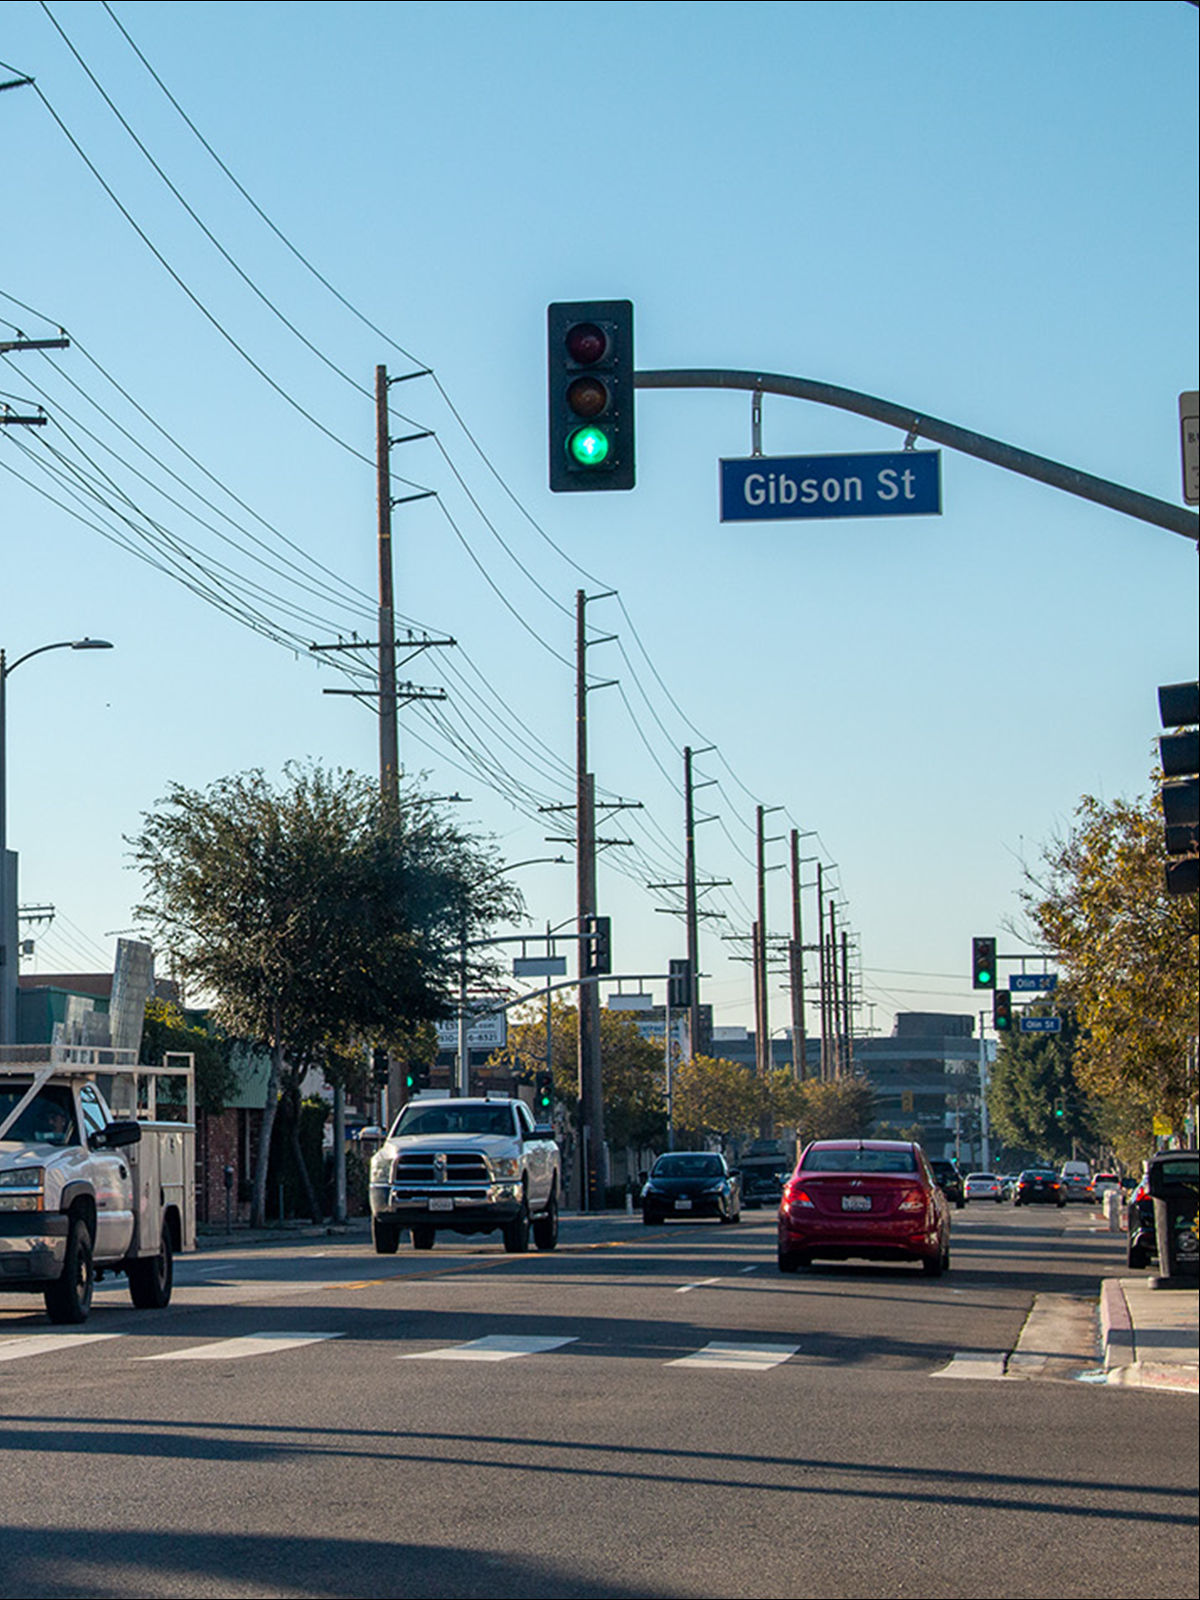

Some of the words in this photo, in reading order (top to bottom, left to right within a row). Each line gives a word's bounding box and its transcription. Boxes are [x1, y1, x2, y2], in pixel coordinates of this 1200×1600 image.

[744, 473, 862, 505] Gibson
[877, 469, 916, 500] St
[1016, 978, 1036, 989] Olin
[1026, 1020, 1042, 1029] Olin
[1045, 1020, 1055, 1029] St
